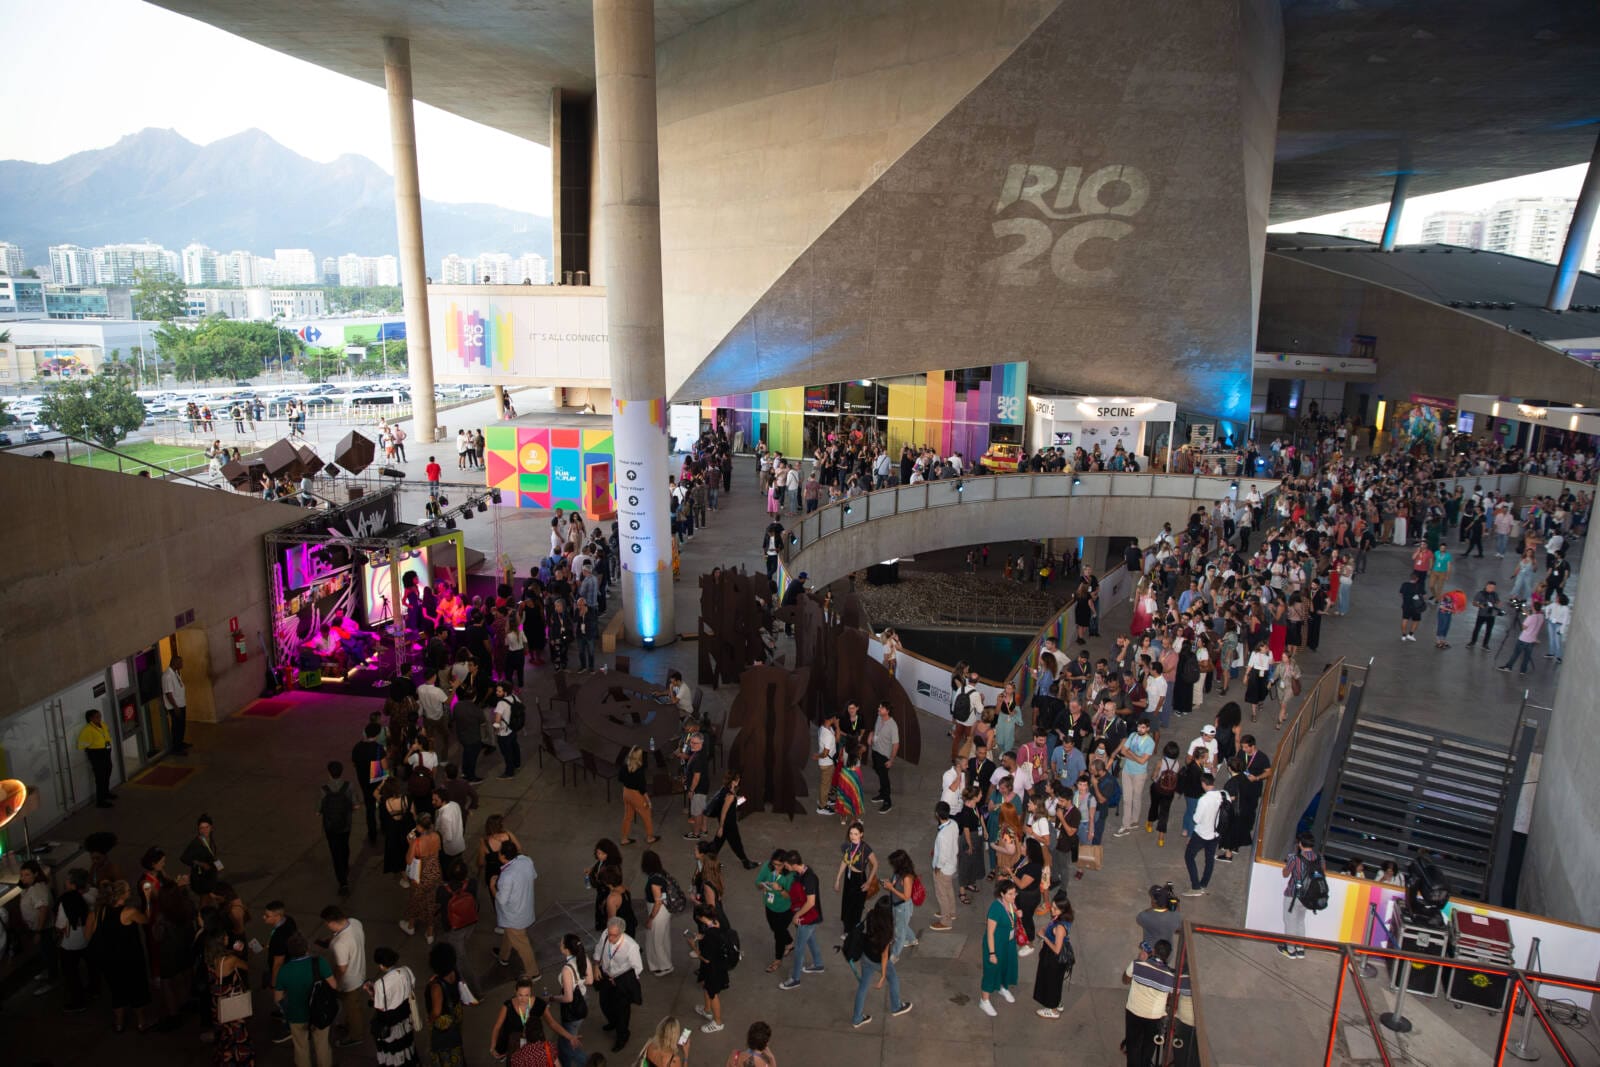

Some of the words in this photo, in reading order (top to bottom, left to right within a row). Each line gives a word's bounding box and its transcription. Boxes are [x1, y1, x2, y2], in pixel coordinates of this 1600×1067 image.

[995, 163, 1150, 220] RIO
[981, 217, 1135, 287] 2C
[464, 324, 483, 334] RIO
[464, 334, 483, 347] 2C
[548, 333, 563, 341] ALL
[565, 334, 608, 342] CONNECT
[998, 396, 1020, 408] RIO
[997, 407, 1018, 419] 2C
[1097, 407, 1135, 417] SPCINE
